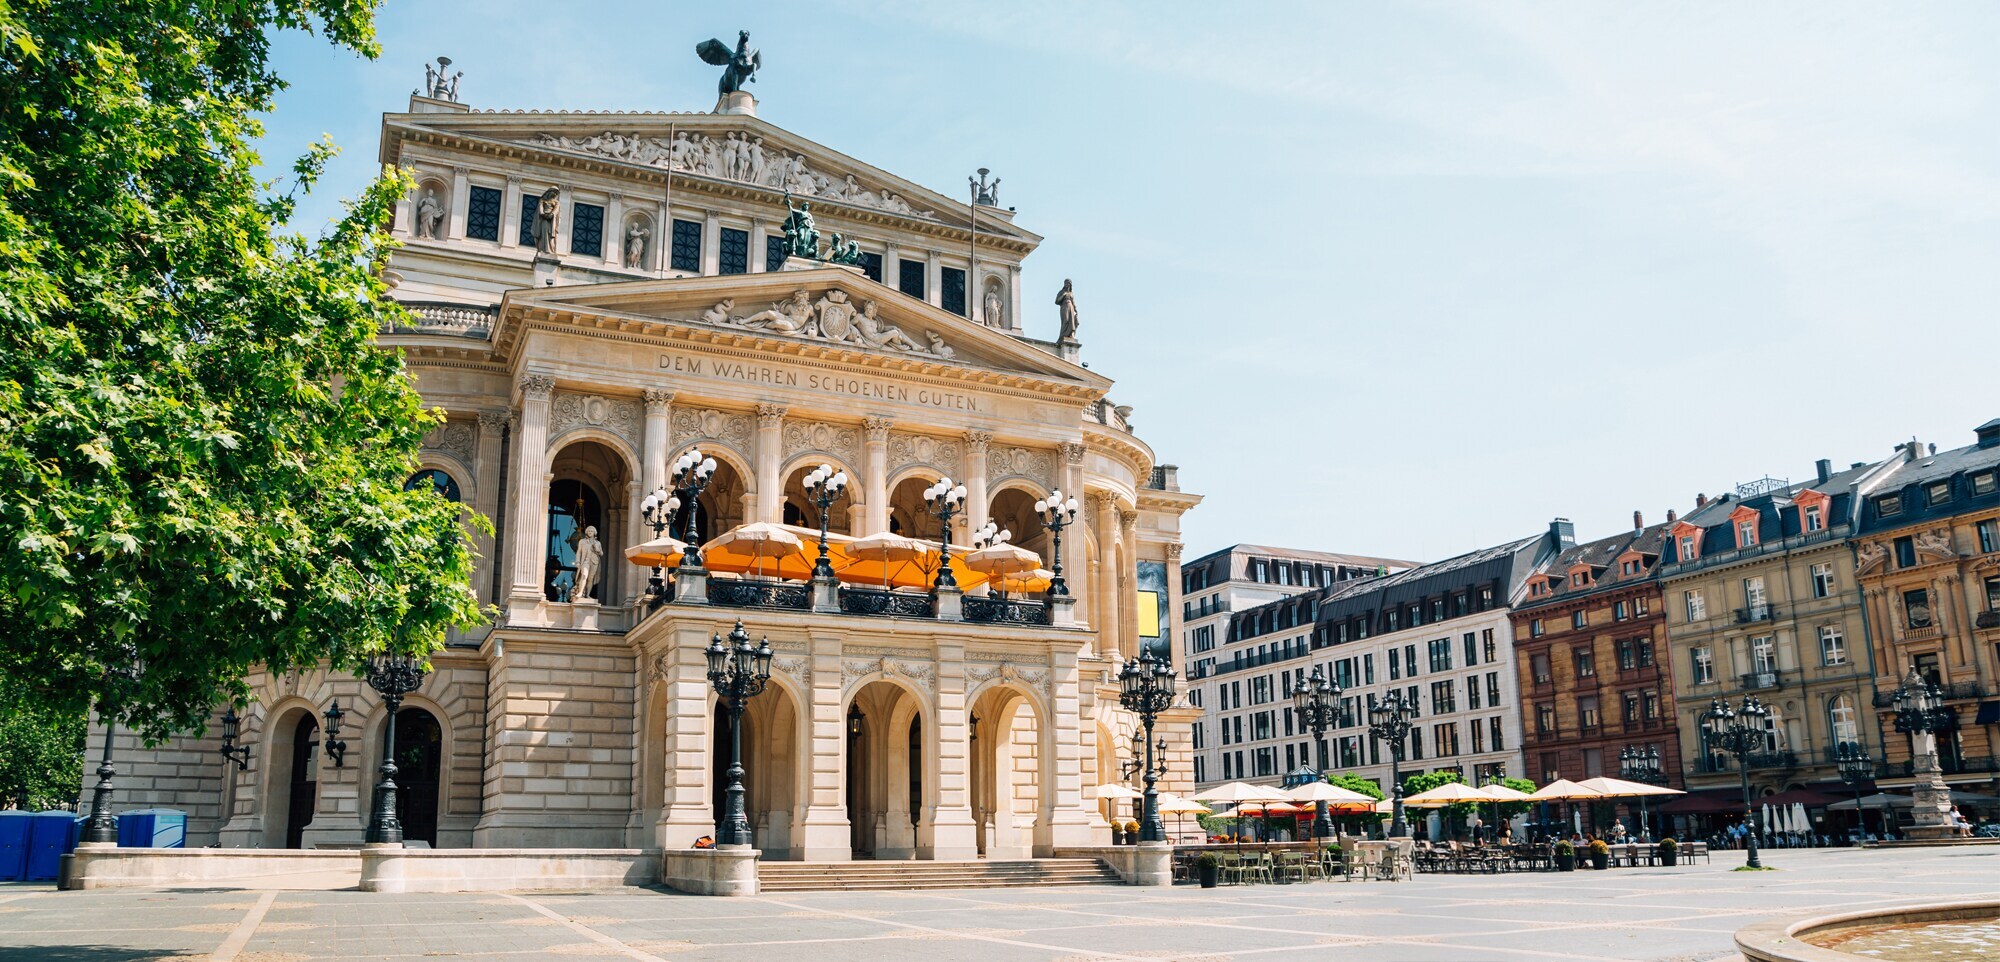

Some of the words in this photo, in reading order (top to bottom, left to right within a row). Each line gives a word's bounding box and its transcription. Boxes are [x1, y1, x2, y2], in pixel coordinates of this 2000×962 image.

[659, 354, 701, 374] DEM
[712, 361, 797, 386] WAHREN
[809, 374, 908, 401] SCHOENEN
[918, 390, 983, 412] GUTEN.
